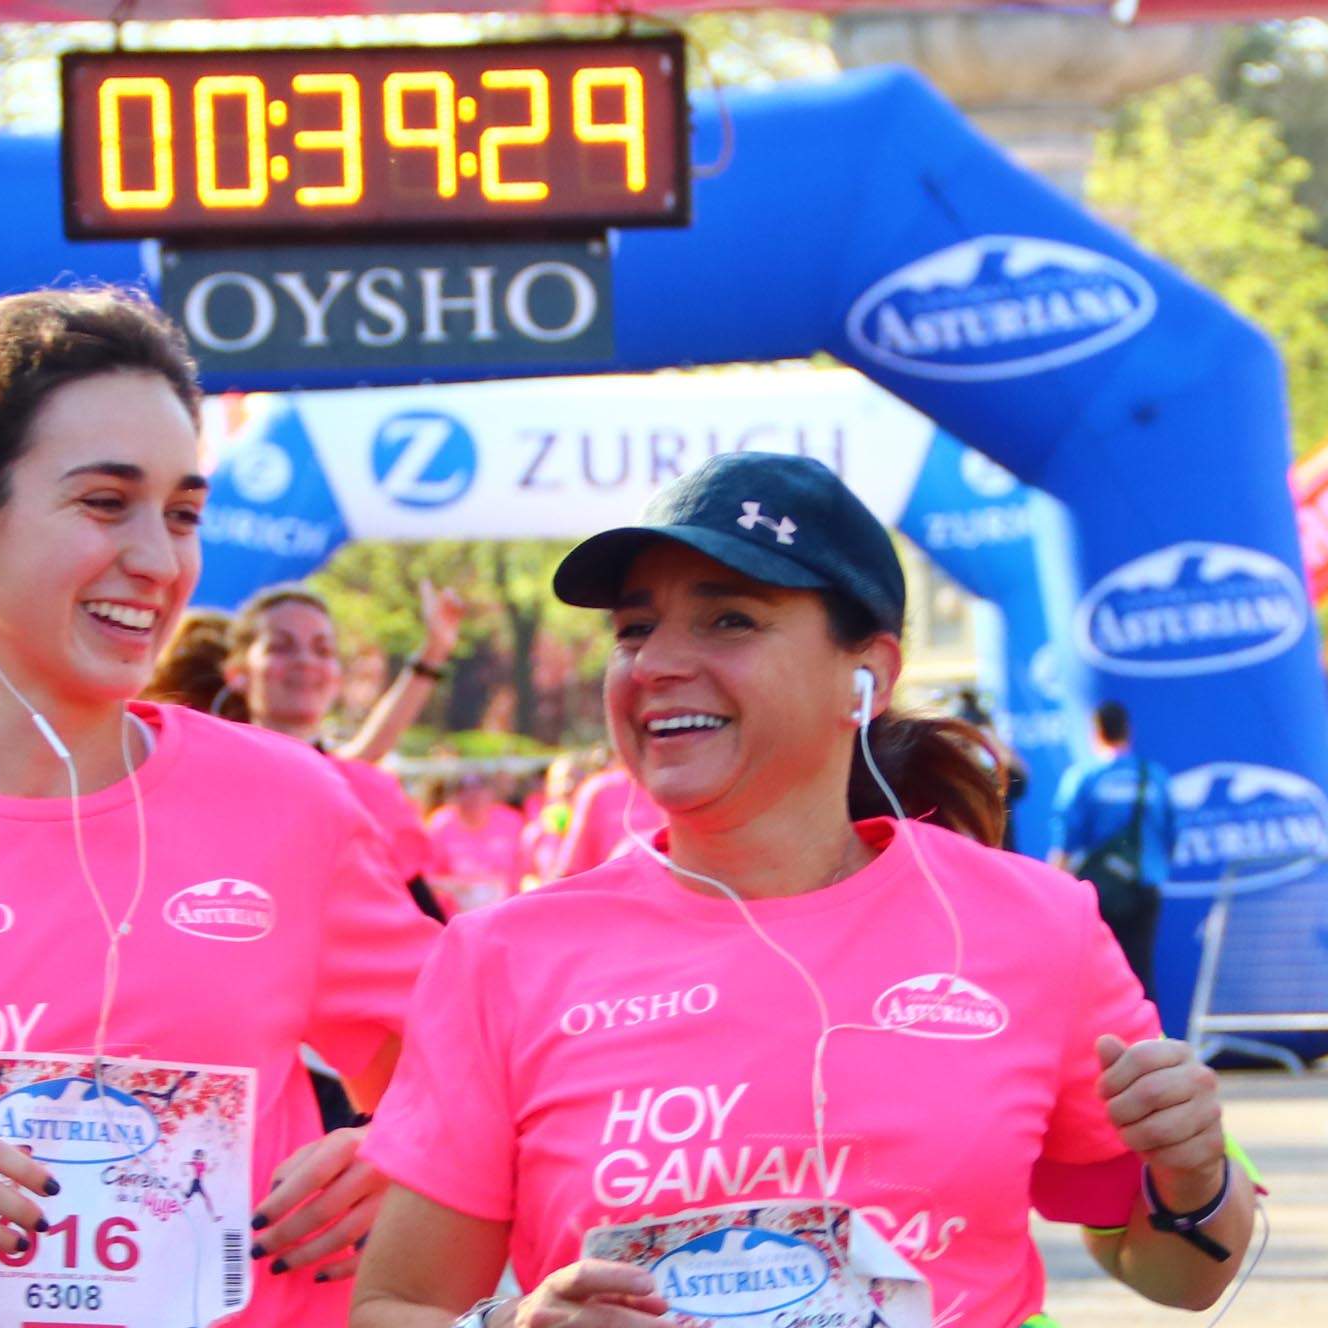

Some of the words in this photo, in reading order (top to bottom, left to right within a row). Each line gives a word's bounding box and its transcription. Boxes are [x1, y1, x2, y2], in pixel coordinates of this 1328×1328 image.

[98, 65, 647, 211] 00:39:29
[183, 260, 599, 353] OYSHO
[875, 284, 1134, 356] ASTURIANA
[559, 982, 719, 1037] OYSHO
[600, 1082, 750, 1146] HOY
[591, 1144, 851, 1209] GANAN
[25, 1283, 104, 1312] 6308
[662, 1261, 816, 1299] ASTURIANA
